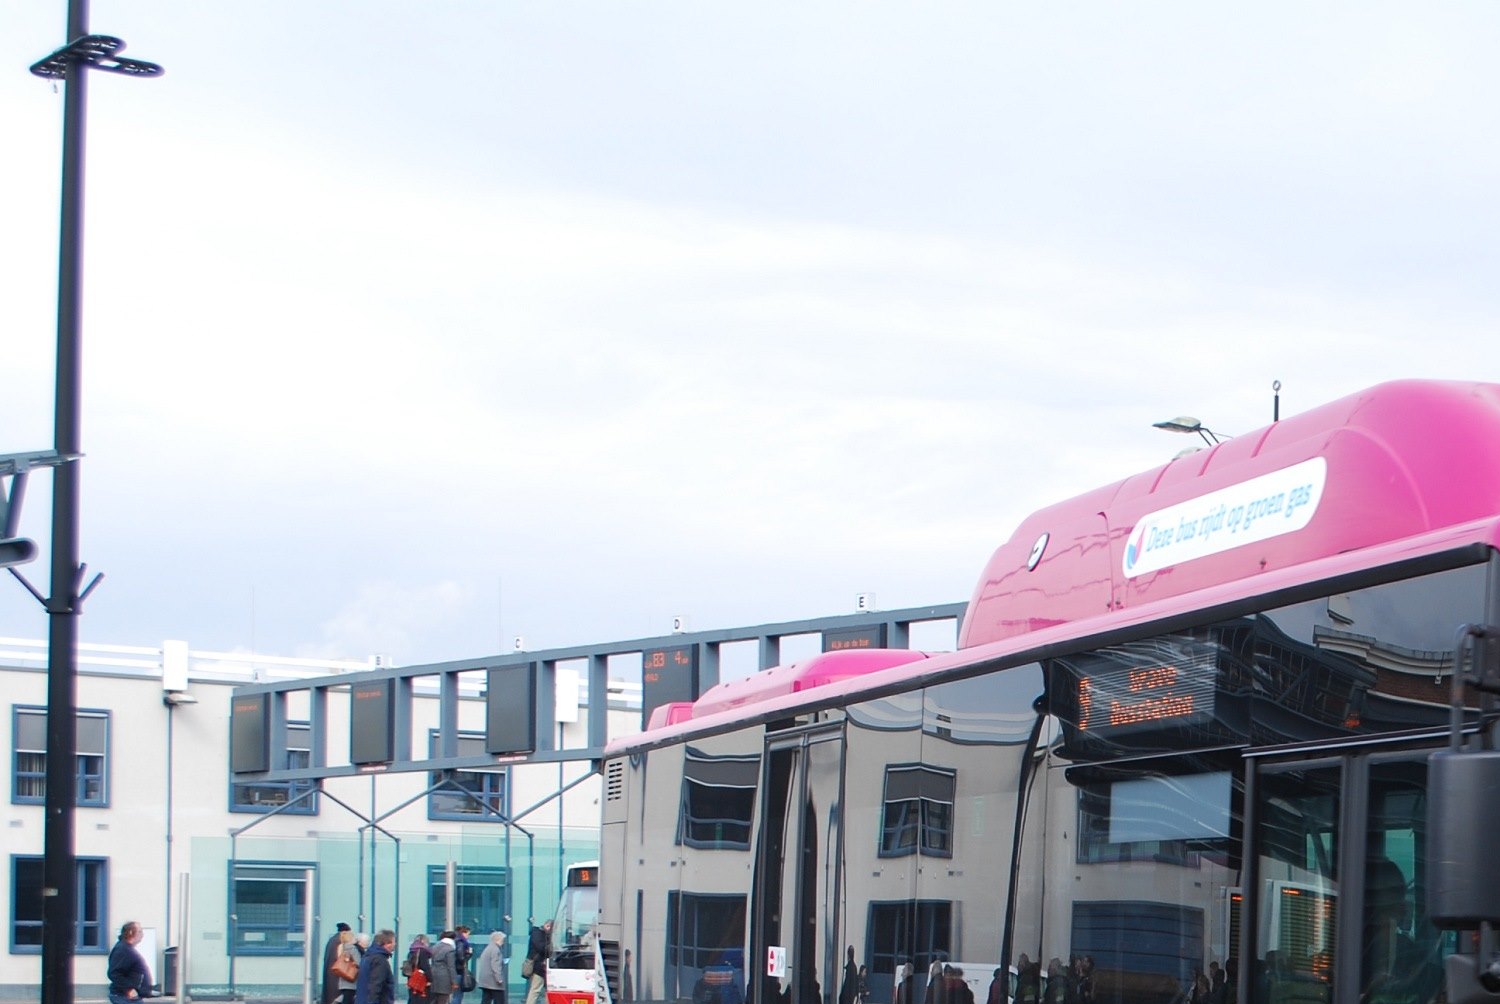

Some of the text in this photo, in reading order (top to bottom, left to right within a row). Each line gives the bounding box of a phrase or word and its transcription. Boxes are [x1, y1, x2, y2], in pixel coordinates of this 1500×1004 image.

[1146, 483, 1313, 552] Deze bus rijdt op groen gas
[859, 596, 865, 608] E
[674, 618, 681, 630] D
